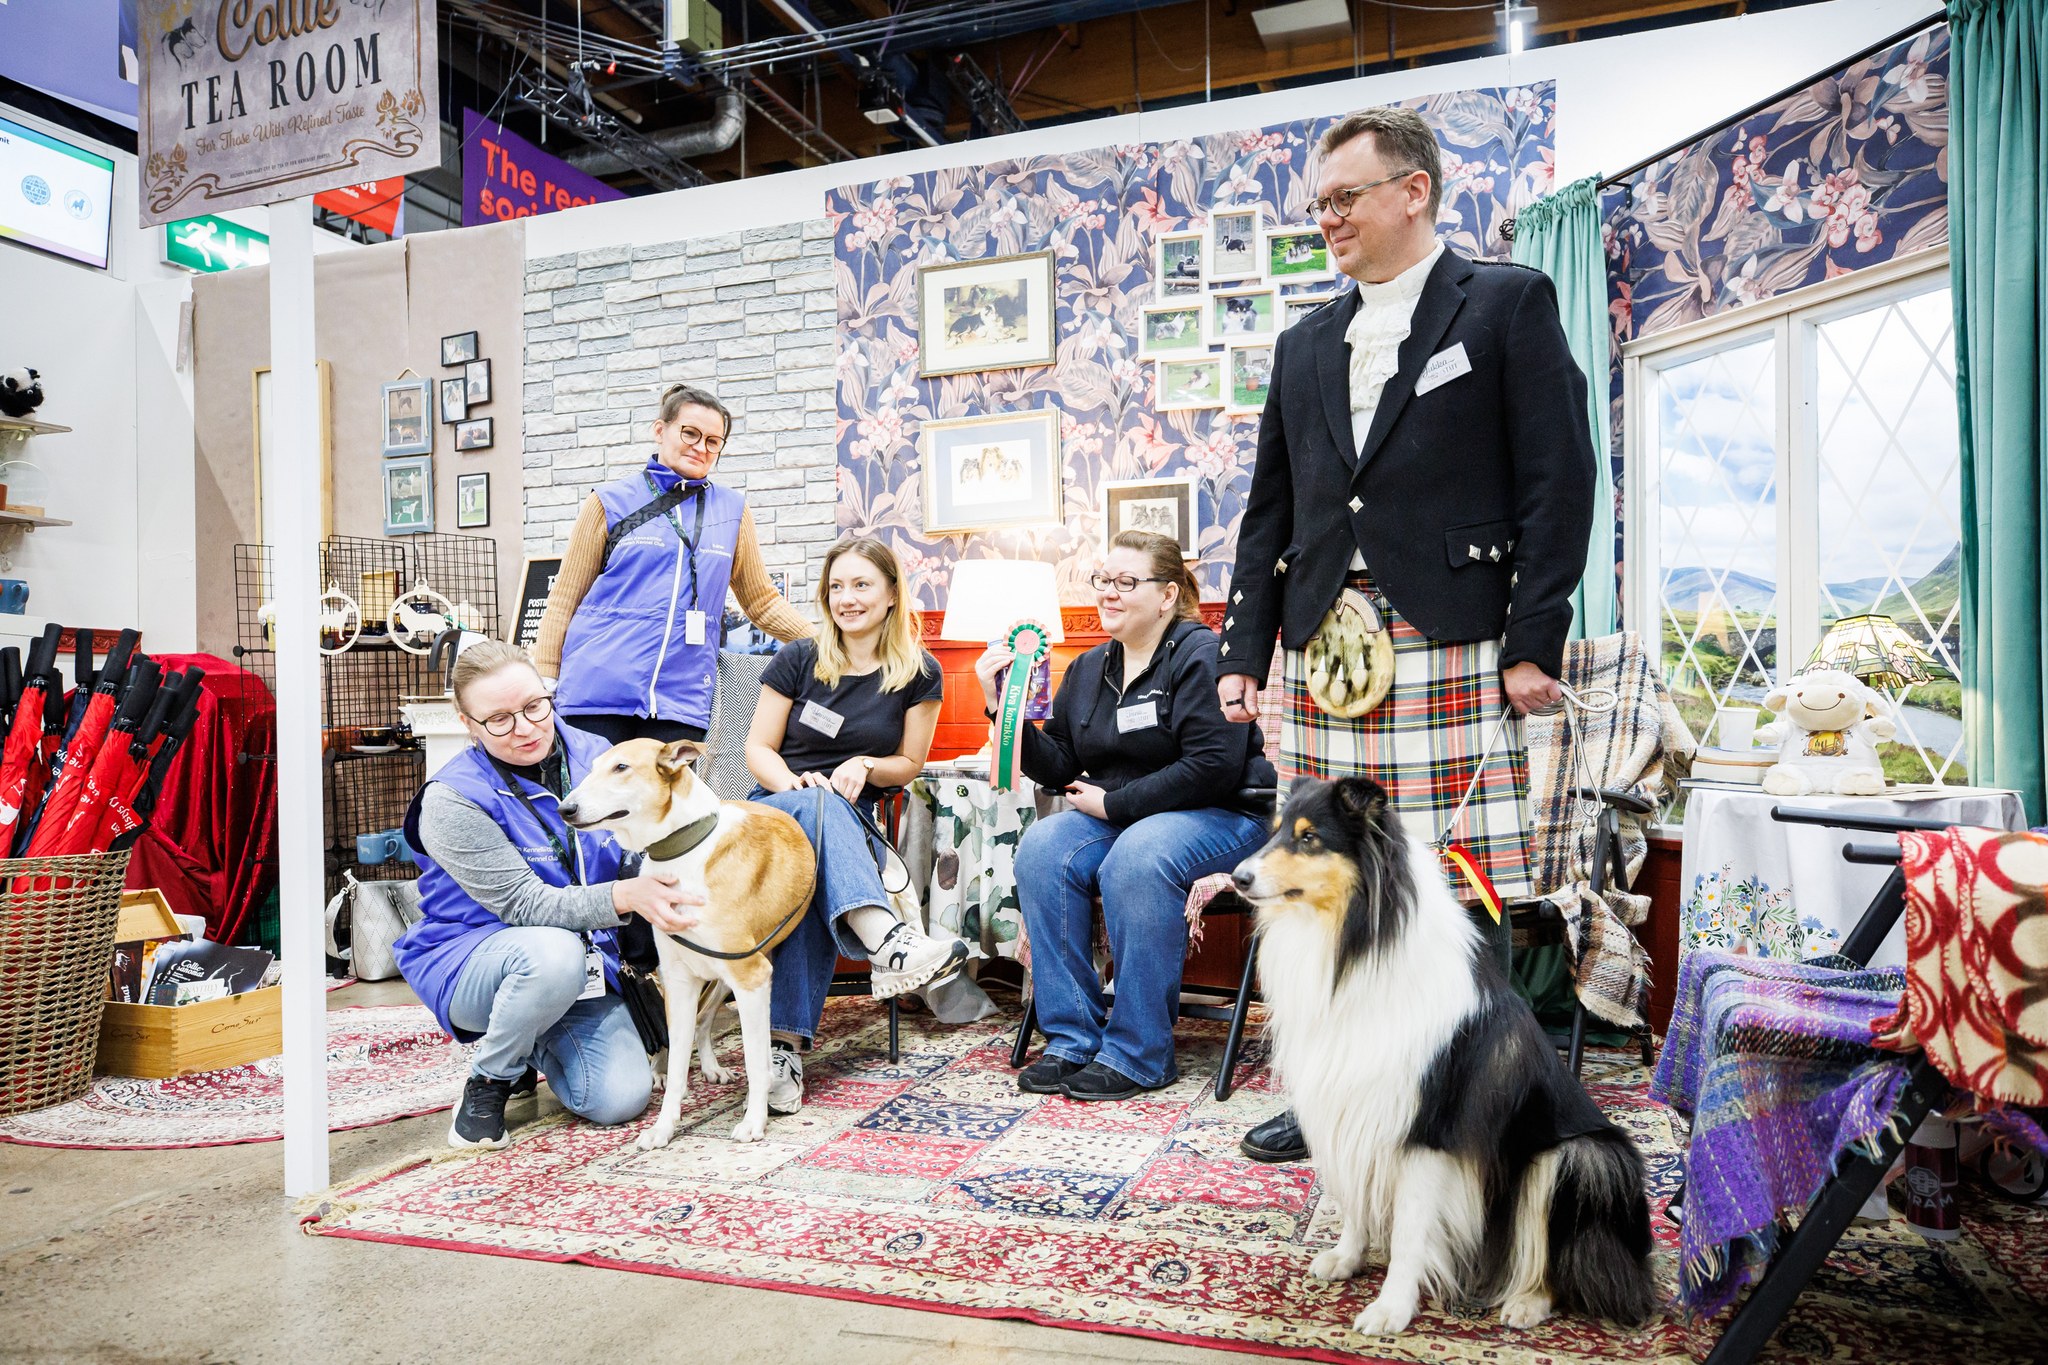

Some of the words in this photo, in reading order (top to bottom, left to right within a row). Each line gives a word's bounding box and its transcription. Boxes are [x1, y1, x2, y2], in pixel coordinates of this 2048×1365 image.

[181, 70, 247, 130] TEA
[268, 32, 382, 110] ROOM
[195, 137, 216, 156] For
[220, 129, 250, 150] Those
[253, 120, 285, 143] With
[288, 111, 332, 135] Refined
[335, 102, 366, 121] Taste
[480, 138, 537, 197] The
[544, 180, 597, 212] re
[528, 598, 548, 608] POSTI
[1007, 684, 1021, 705] Kiva
[1002, 706, 1017, 746] koirakko
